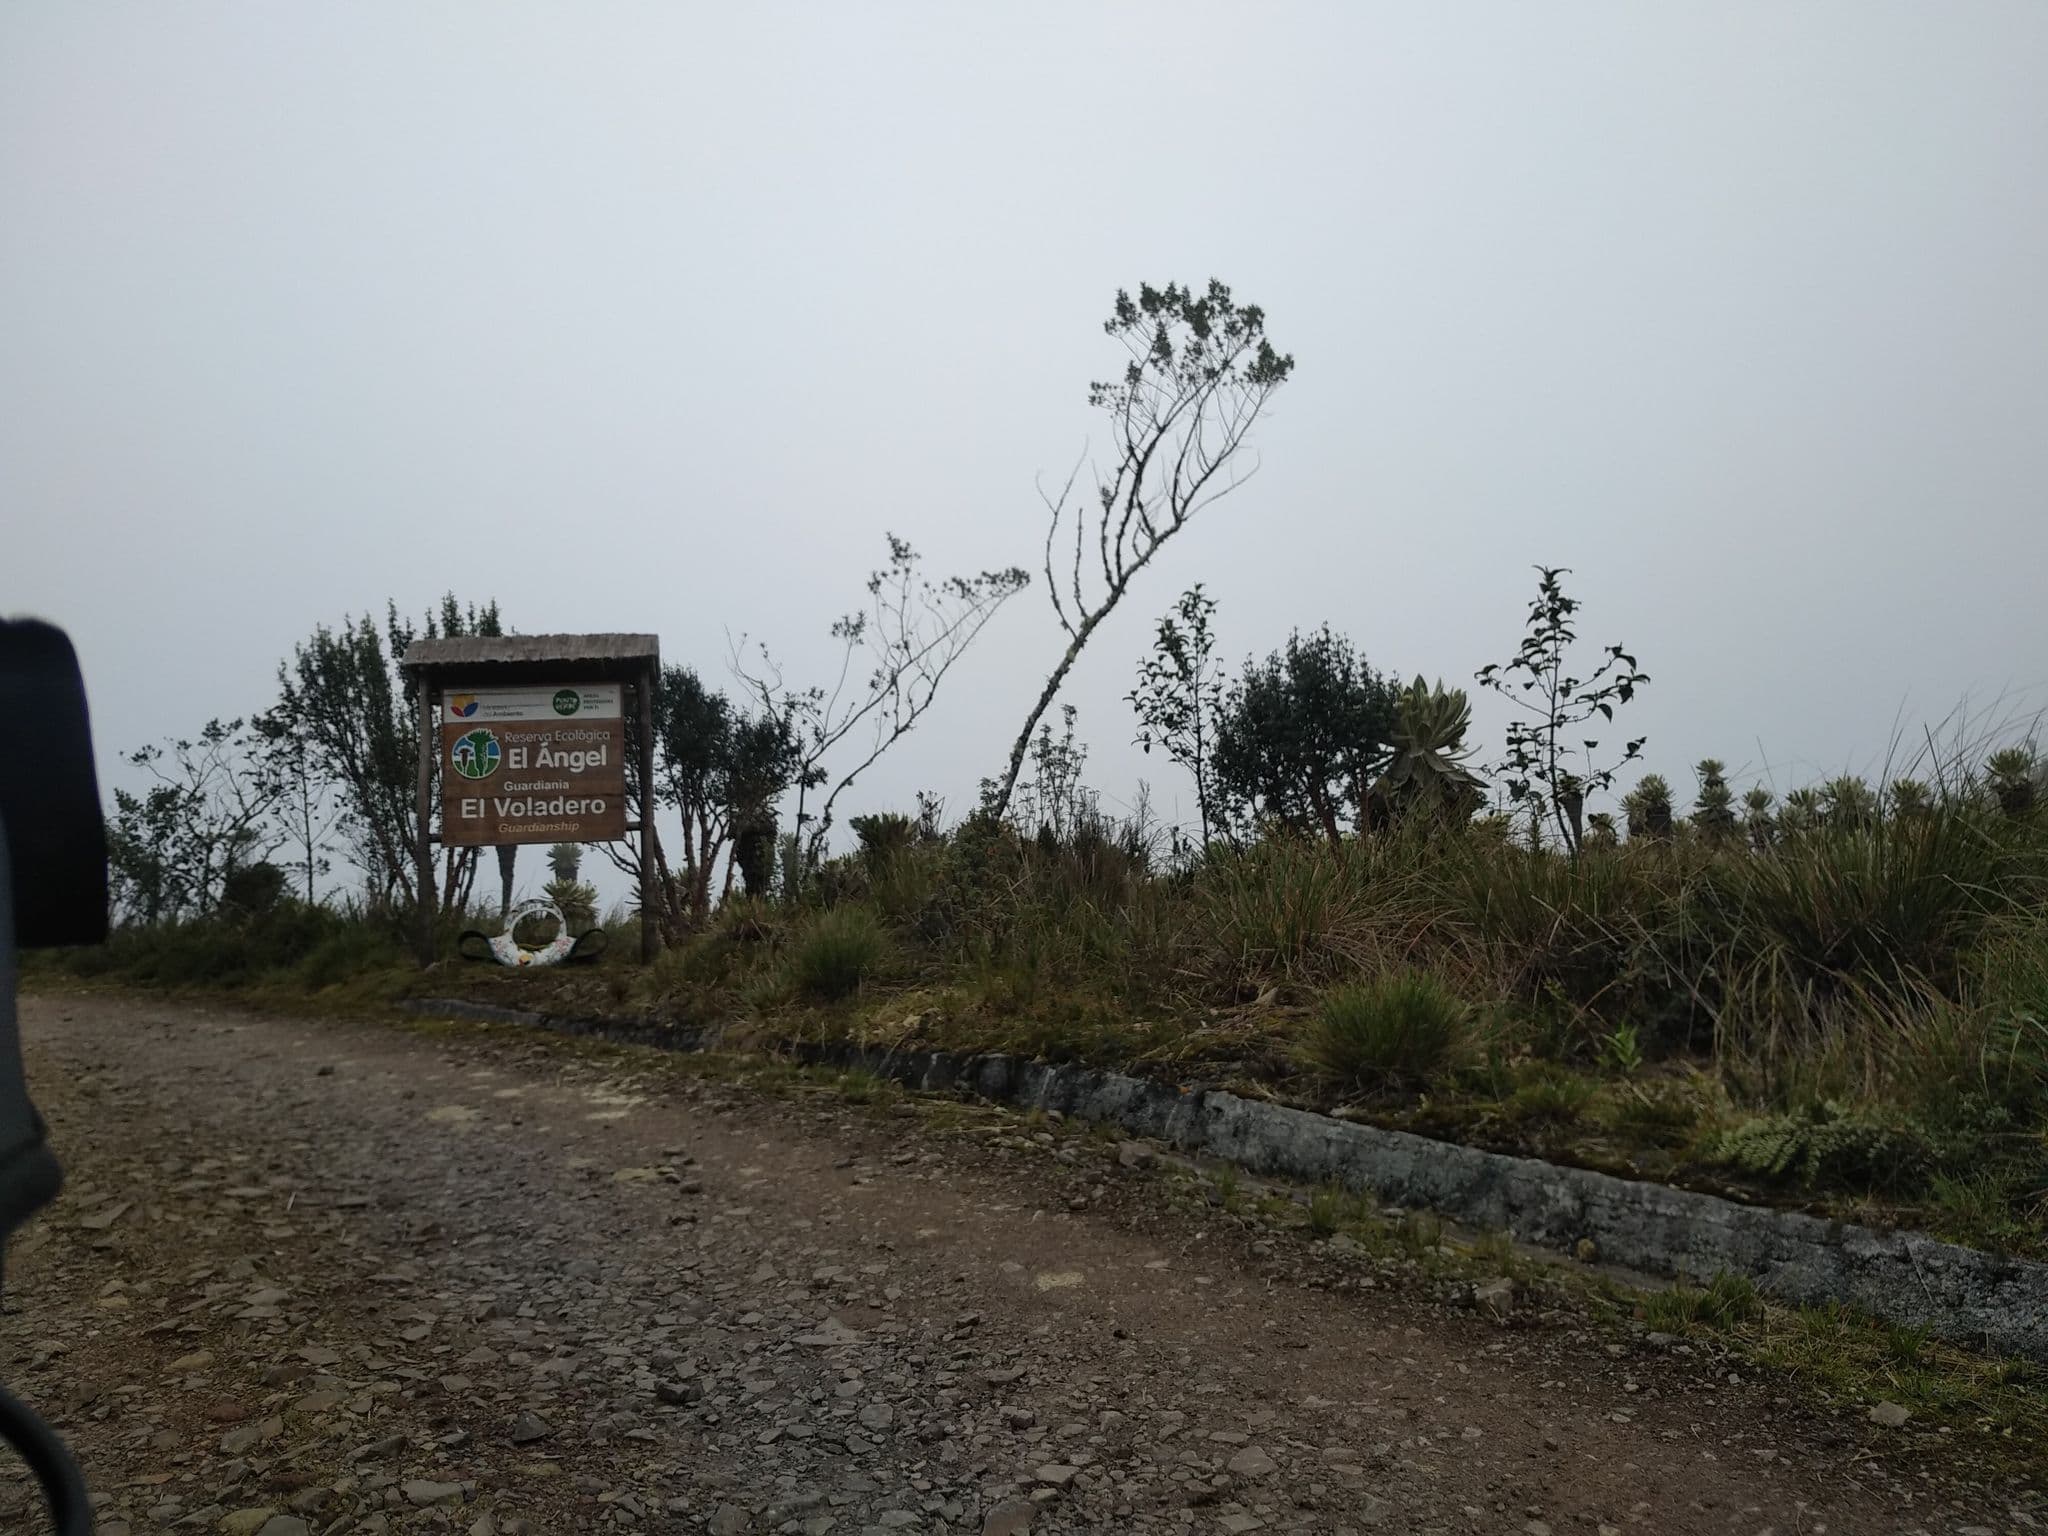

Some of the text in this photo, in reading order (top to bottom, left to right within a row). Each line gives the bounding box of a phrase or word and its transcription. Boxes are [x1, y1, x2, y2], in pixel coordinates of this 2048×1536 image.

[504, 729, 611, 744] Reserva Ecológica
[508, 742, 607, 773] El Ángel
[461, 796, 606, 819] El Voladero
[498, 821, 580, 833] Guardianship
